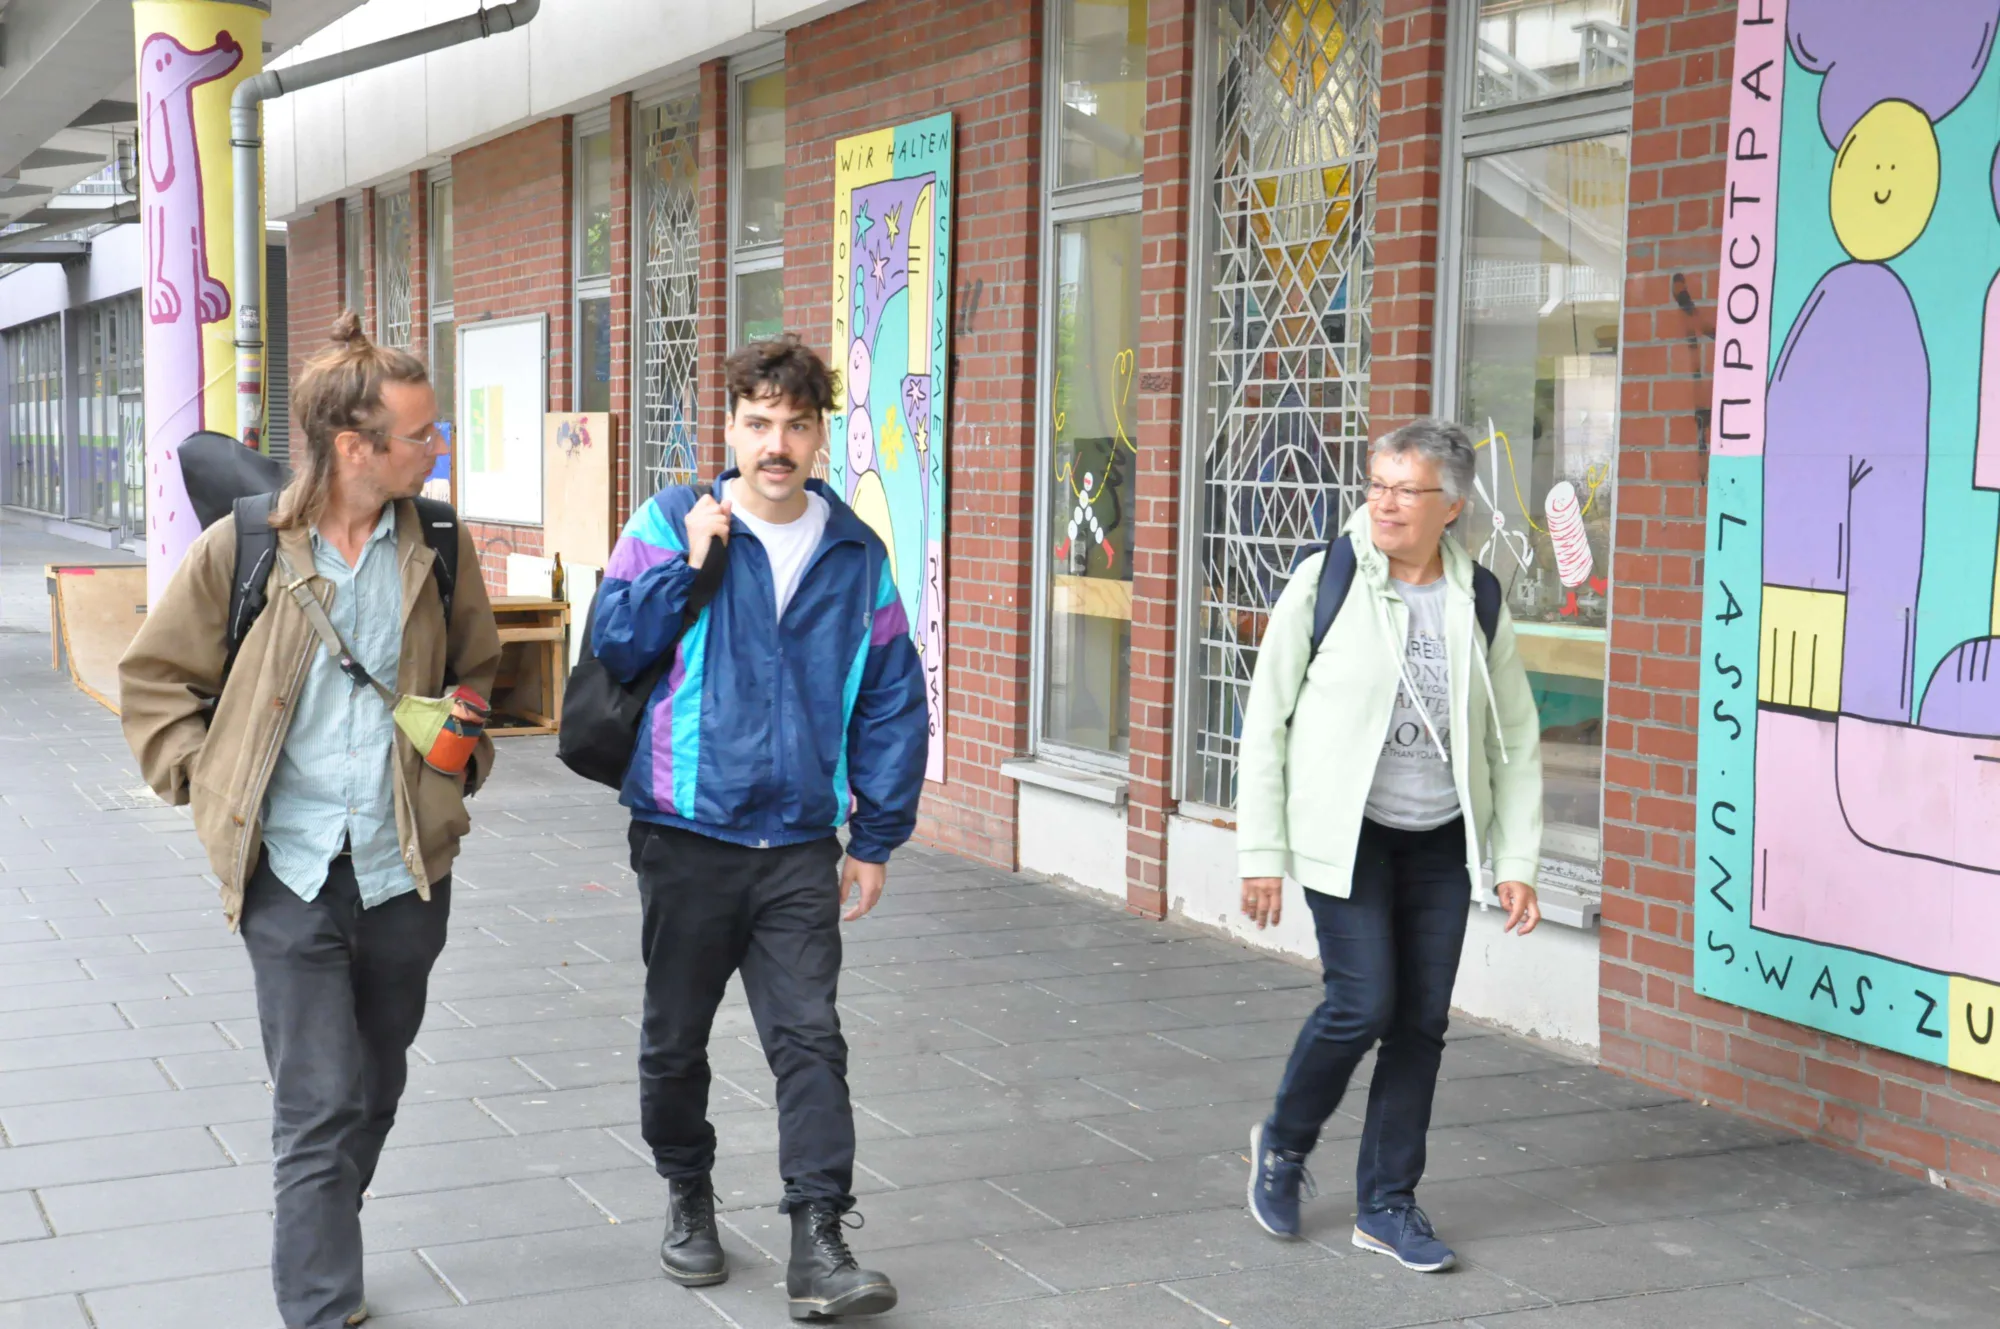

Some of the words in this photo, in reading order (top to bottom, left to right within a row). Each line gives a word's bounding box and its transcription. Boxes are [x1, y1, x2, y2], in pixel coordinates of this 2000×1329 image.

[887, 130, 948, 164] HALTEN
[834, 209, 848, 337] COME
[931, 180, 948, 487] ZUSAMMEN
[1714, 512, 1746, 740] LASS
[1707, 801, 1736, 965] UNS
[1755, 950, 1872, 1016] WAS
